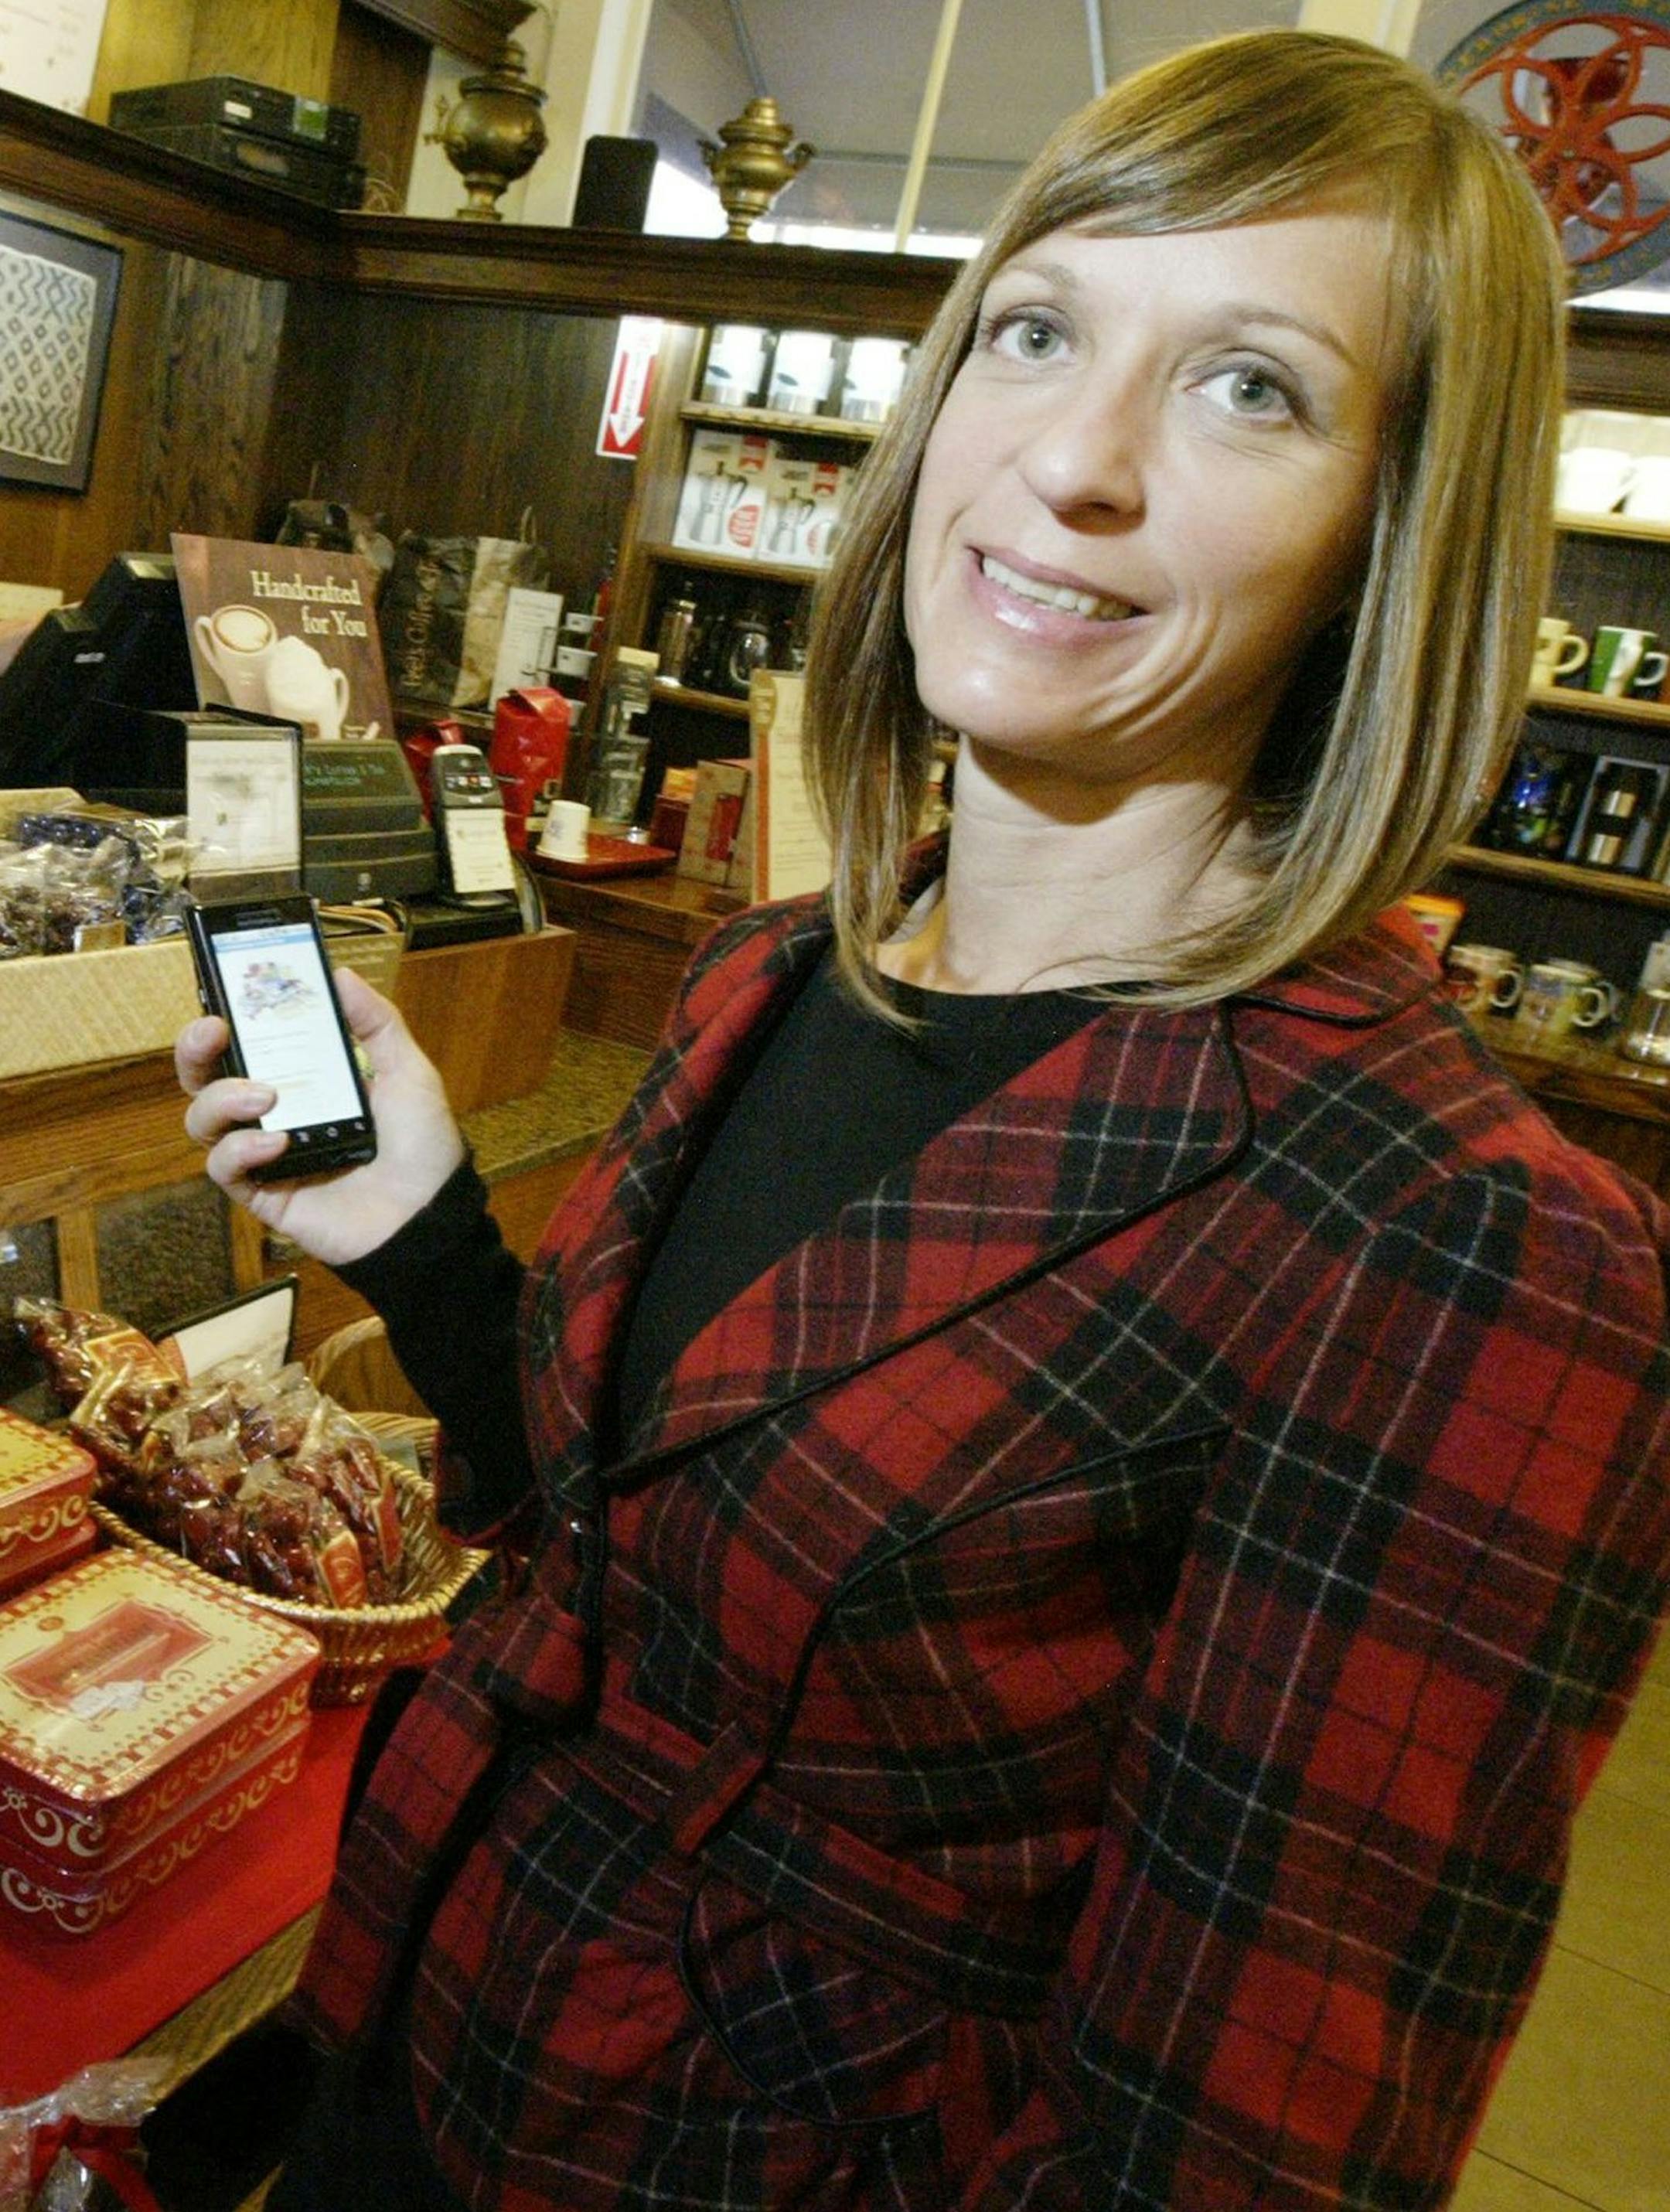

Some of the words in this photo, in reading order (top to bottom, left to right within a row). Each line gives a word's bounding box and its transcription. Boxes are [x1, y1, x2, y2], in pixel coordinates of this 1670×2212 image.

[250, 571, 362, 605] Handcrafted
[301, 605, 329, 634] for
[330, 609, 367, 637] You
